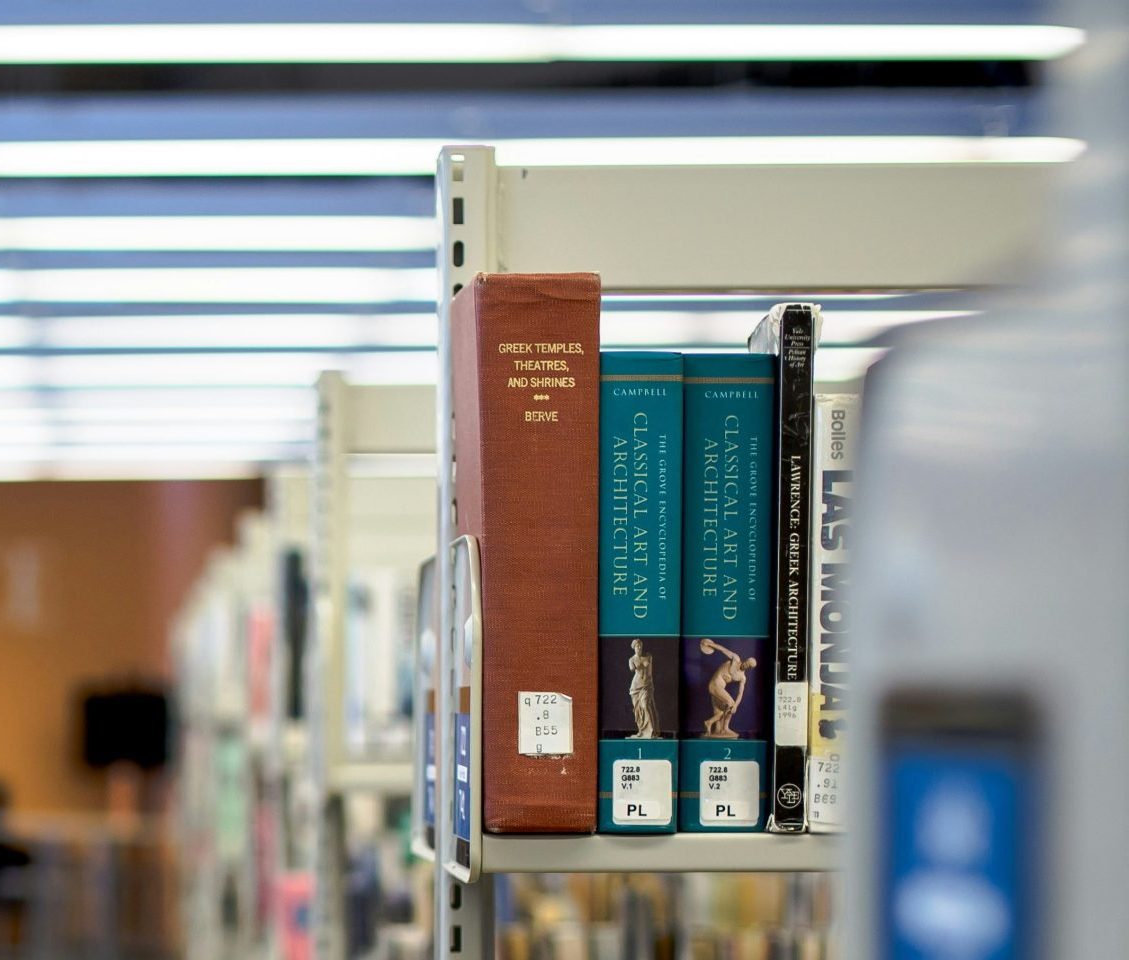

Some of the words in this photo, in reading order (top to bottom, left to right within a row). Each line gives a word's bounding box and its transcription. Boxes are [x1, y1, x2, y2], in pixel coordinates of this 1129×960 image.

[498, 343, 532, 353] GREEK
[535, 343, 584, 355] TEMPLES,
[513, 360, 569, 372] THEATRES,
[507, 377, 528, 388] AND
[530, 377, 576, 388] SHRINES
[613, 387, 667, 397] CAMPBELL
[704, 390, 759, 399] CAMPBELL
[525, 411, 559, 422] BERVE
[658, 433, 667, 455] THE
[831, 409, 847, 460] Bolles
[749, 436, 758, 457] THE
[633, 412, 648, 519] CLASSICAL
[723, 414, 739, 521] CLASSICAL
[658, 459, 667, 496] GROVE
[749, 461, 758, 497] GROVE
[788, 455, 801, 528] LAWRENCE:
[613, 435, 628, 596] ARCHITECTURE
[702, 438, 719, 597] ARCHITECTURE
[821, 470, 854, 552] LAS
[633, 526, 648, 566] ART
[658, 500, 667, 582] ENCYCLOPEDIA
[723, 527, 738, 568] ART
[748, 502, 757, 584] ENCYCLOPEDIA
[788, 532, 800, 576] GREEK
[633, 573, 648, 619] AND
[658, 586, 667, 600] OF
[722, 574, 738, 620] AND
[748, 588, 757, 601] OF
[786, 579, 800, 681] ARCHITECTURE
[535, 694, 557, 704] 722
[536, 710, 550, 719] .8
[535, 725, 558, 736] B55
[638, 748, 643, 760] 1
[724, 748, 732, 760] 2
[818, 761, 840, 773] 722
[621, 774, 640, 782] G883
[627, 804, 647, 817] PL
[715, 804, 736, 817] PL
